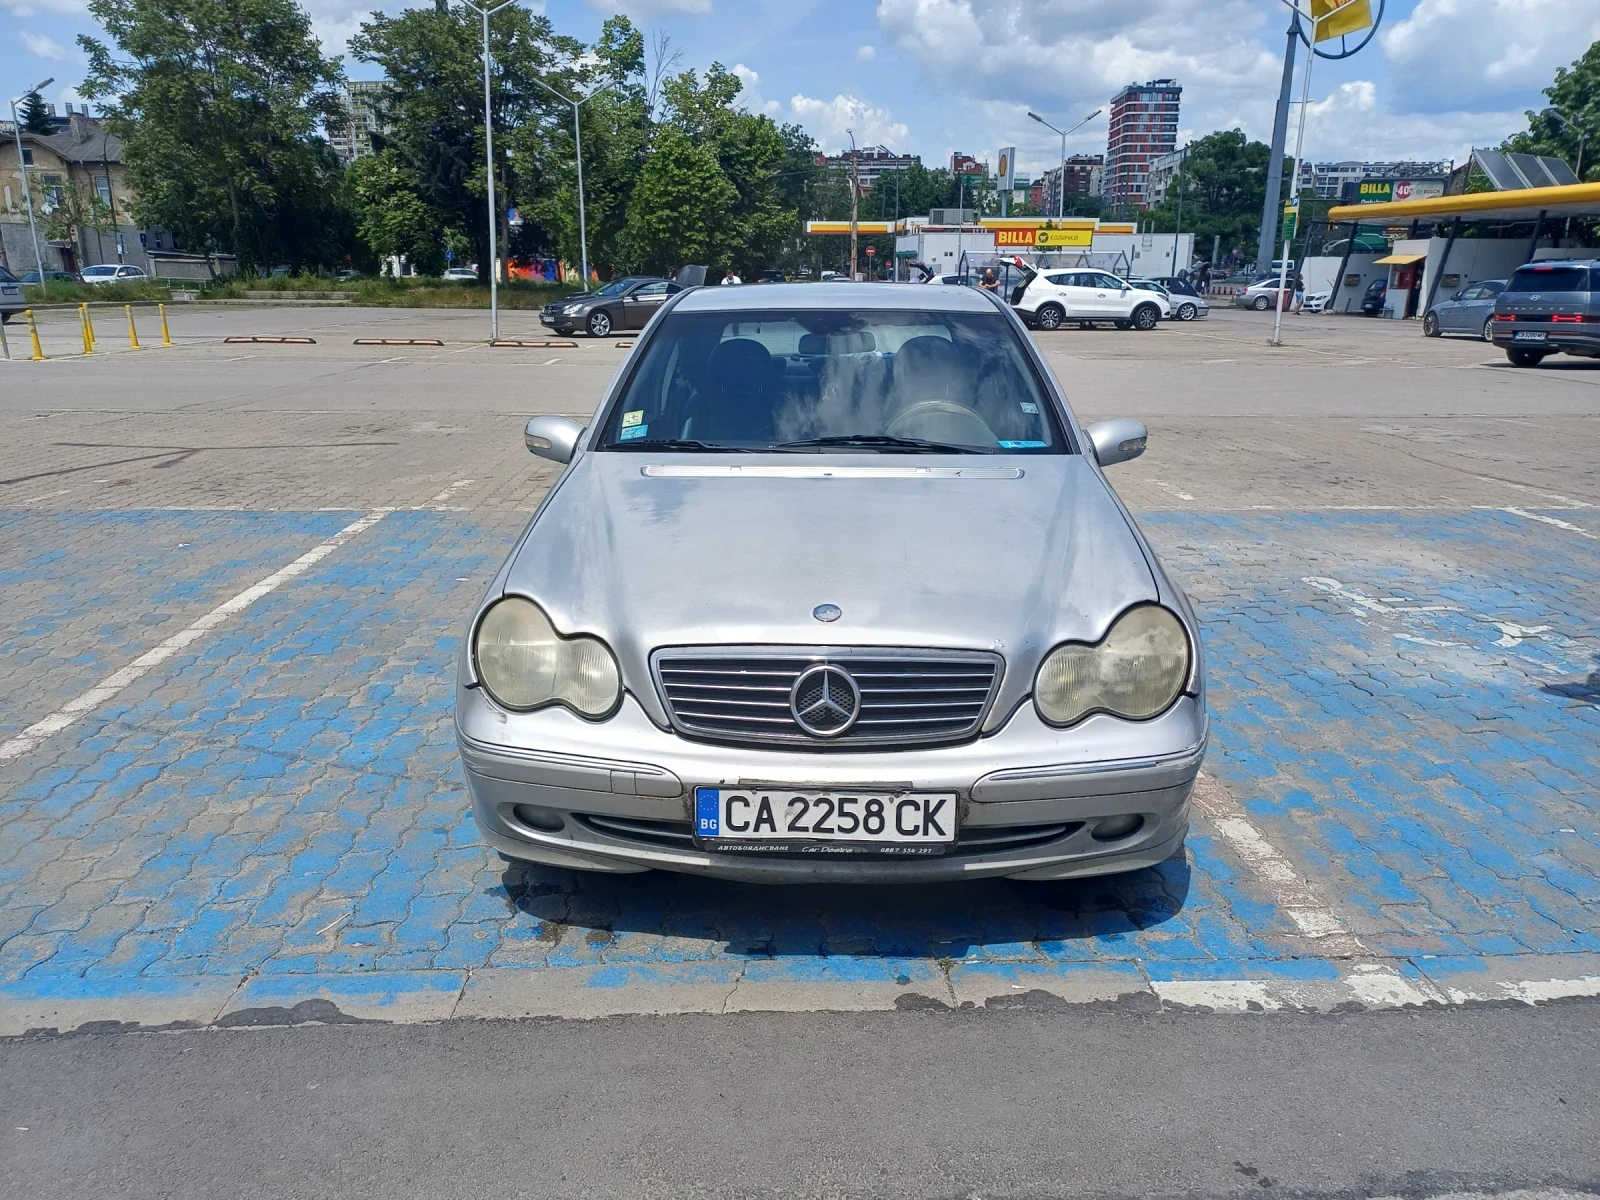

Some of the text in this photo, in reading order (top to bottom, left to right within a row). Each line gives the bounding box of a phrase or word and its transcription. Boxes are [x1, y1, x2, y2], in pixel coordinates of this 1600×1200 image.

[1360, 183, 1391, 194] BILLA
[998, 231, 1034, 244] BILLA
[725, 796, 947, 836] CA 2258 CK
[701, 818, 718, 830] BG
